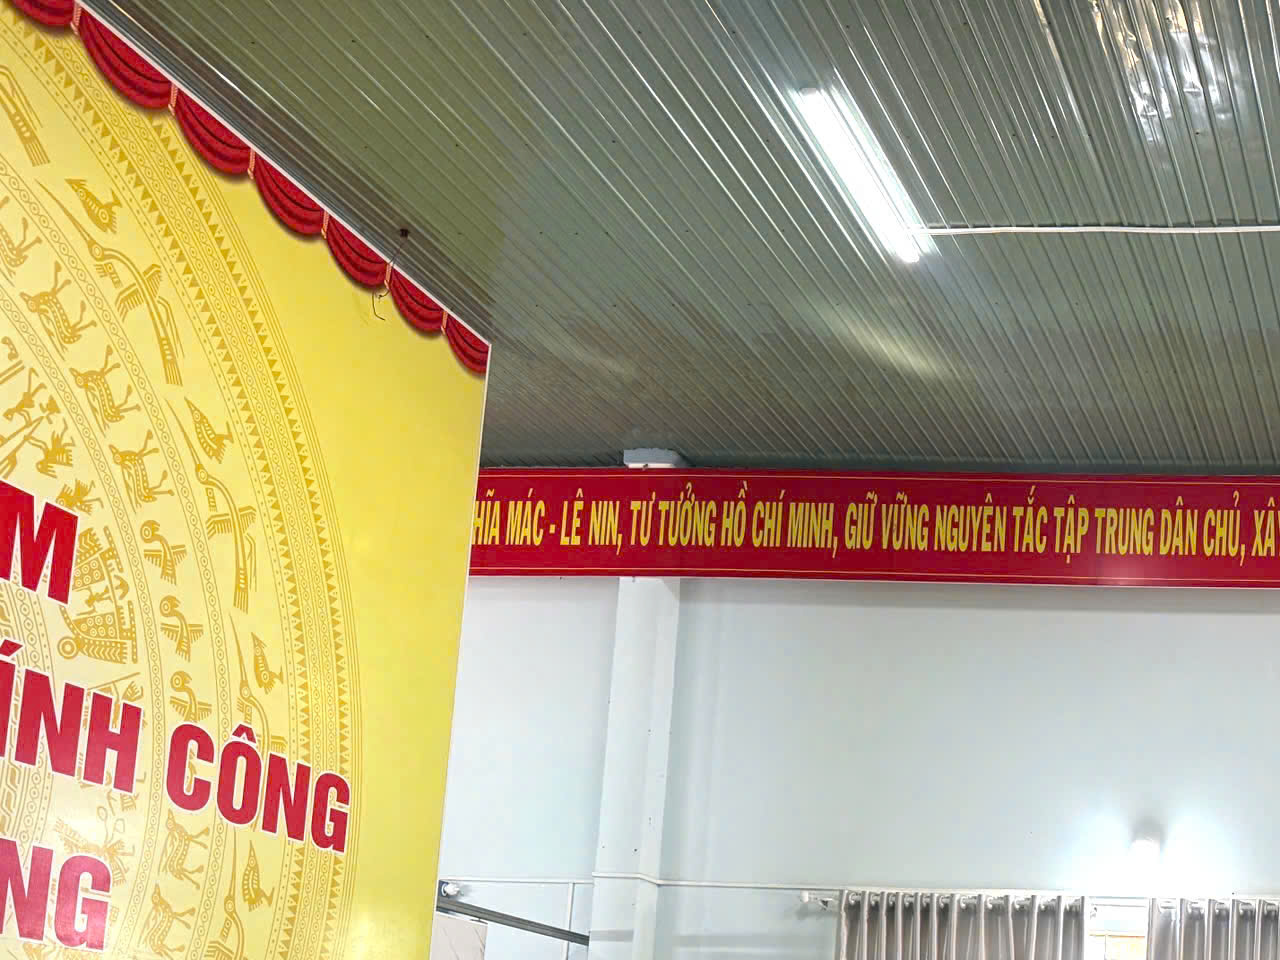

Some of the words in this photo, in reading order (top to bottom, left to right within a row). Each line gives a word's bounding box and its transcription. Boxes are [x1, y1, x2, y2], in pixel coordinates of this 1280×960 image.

[505, 488, 546, 546] MÁC
[549, 523, 556, 534] -
[560, 488, 584, 545] LÊ
[588, 500, 622, 555] NIN,
[631, 492, 656, 545] TƯ
[658, 483, 717, 547] TƯỞNG
[720, 481, 748, 546] HỒ
[752, 489, 785, 547] CHÍ
[787, 502, 838, 558] MINH,
[844, 491, 878, 549] GIỮ
[881, 491, 929, 551] VỮNG
[933, 492, 1006, 552] NGUYÊN
[1012, 485, 1048, 553] TẮC
[1053, 495, 1089, 563] TẬP
[1095, 507, 1154, 555] TRUNG
[1159, 496, 1197, 556] DÂN
[1203, 491, 1245, 567] CHỦ,
[166, 723, 351, 853] CÔNG
